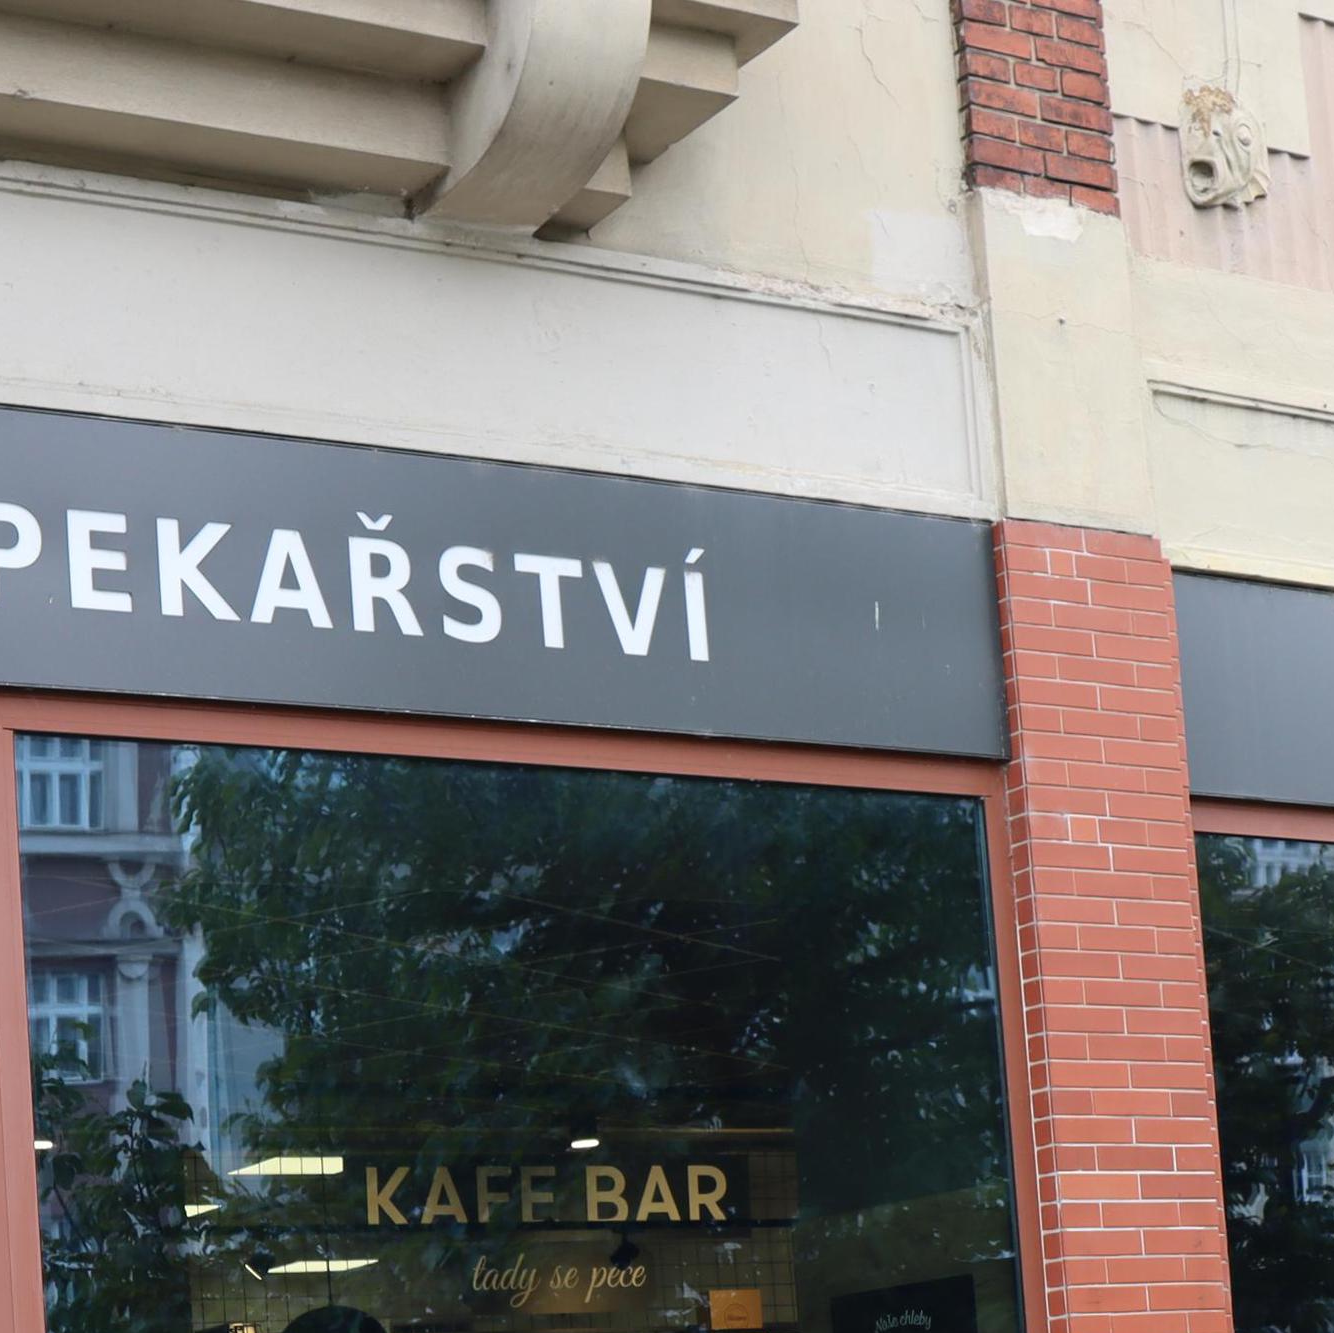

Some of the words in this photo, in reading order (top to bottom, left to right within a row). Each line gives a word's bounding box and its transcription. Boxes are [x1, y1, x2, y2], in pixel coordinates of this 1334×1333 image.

[365, 1165, 557, 1225] KAFE
[585, 1164, 728, 1222] BAR
[472, 1253, 540, 1308] tady
[548, 1264, 580, 1290] se
